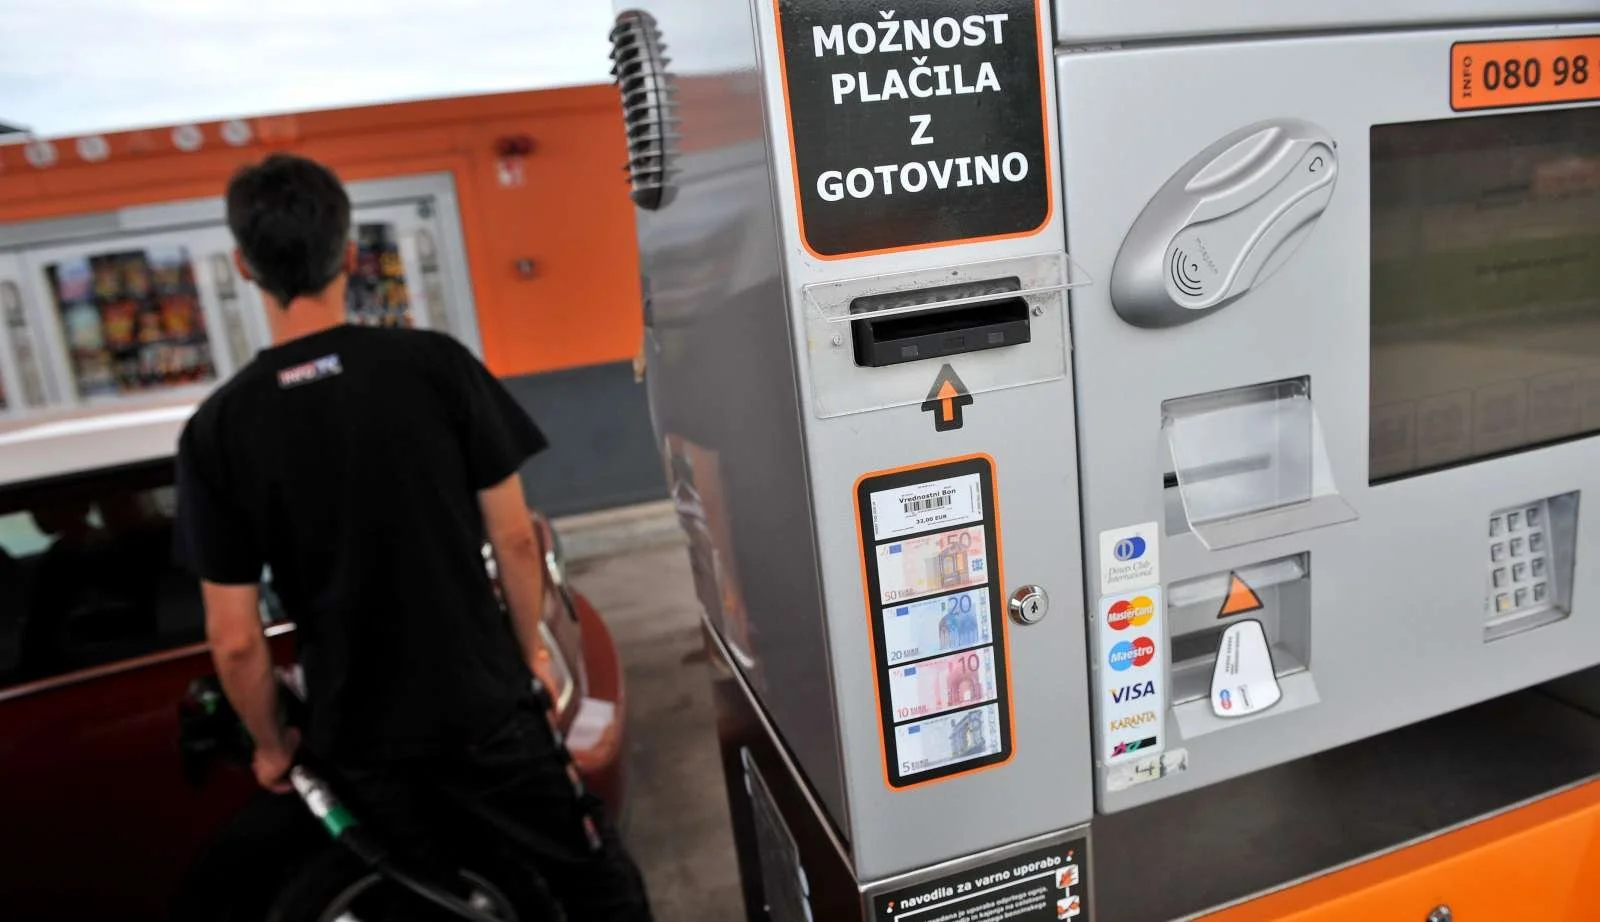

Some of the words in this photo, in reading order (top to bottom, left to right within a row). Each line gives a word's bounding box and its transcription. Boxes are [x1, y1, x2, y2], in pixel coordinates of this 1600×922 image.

[812, 10, 1009, 57] MOŽNOST
[831, 56, 1001, 104] PLAČILA
[1463, 56, 1472, 98] INFO
[1484, 59, 1541, 90] 080
[1552, 54, 1589, 87] 98
[909, 114, 934, 145] Z
[816, 152, 1029, 201] GOTOVINO
[899, 492, 940, 504] Vrednostni
[942, 488, 957, 496] Bon
[935, 514, 947, 522] EUR
[884, 590, 897, 601] 50
[949, 594, 972, 613] 20
[1107, 606, 1153, 623] MasterCard
[890, 650, 903, 661] 20
[958, 653, 980, 673] 10
[1110, 646, 1154, 662] Maestro
[1111, 680, 1155, 704] VISA
[896, 707, 909, 719] 10
[1110, 711, 1156, 732] KARANTA
[902, 761, 911, 773] 5
[900, 886, 954, 910] navodila
[956, 881, 973, 894] za
[975, 871, 1011, 889] varno
[1014, 857, 1062, 877] uporabo
